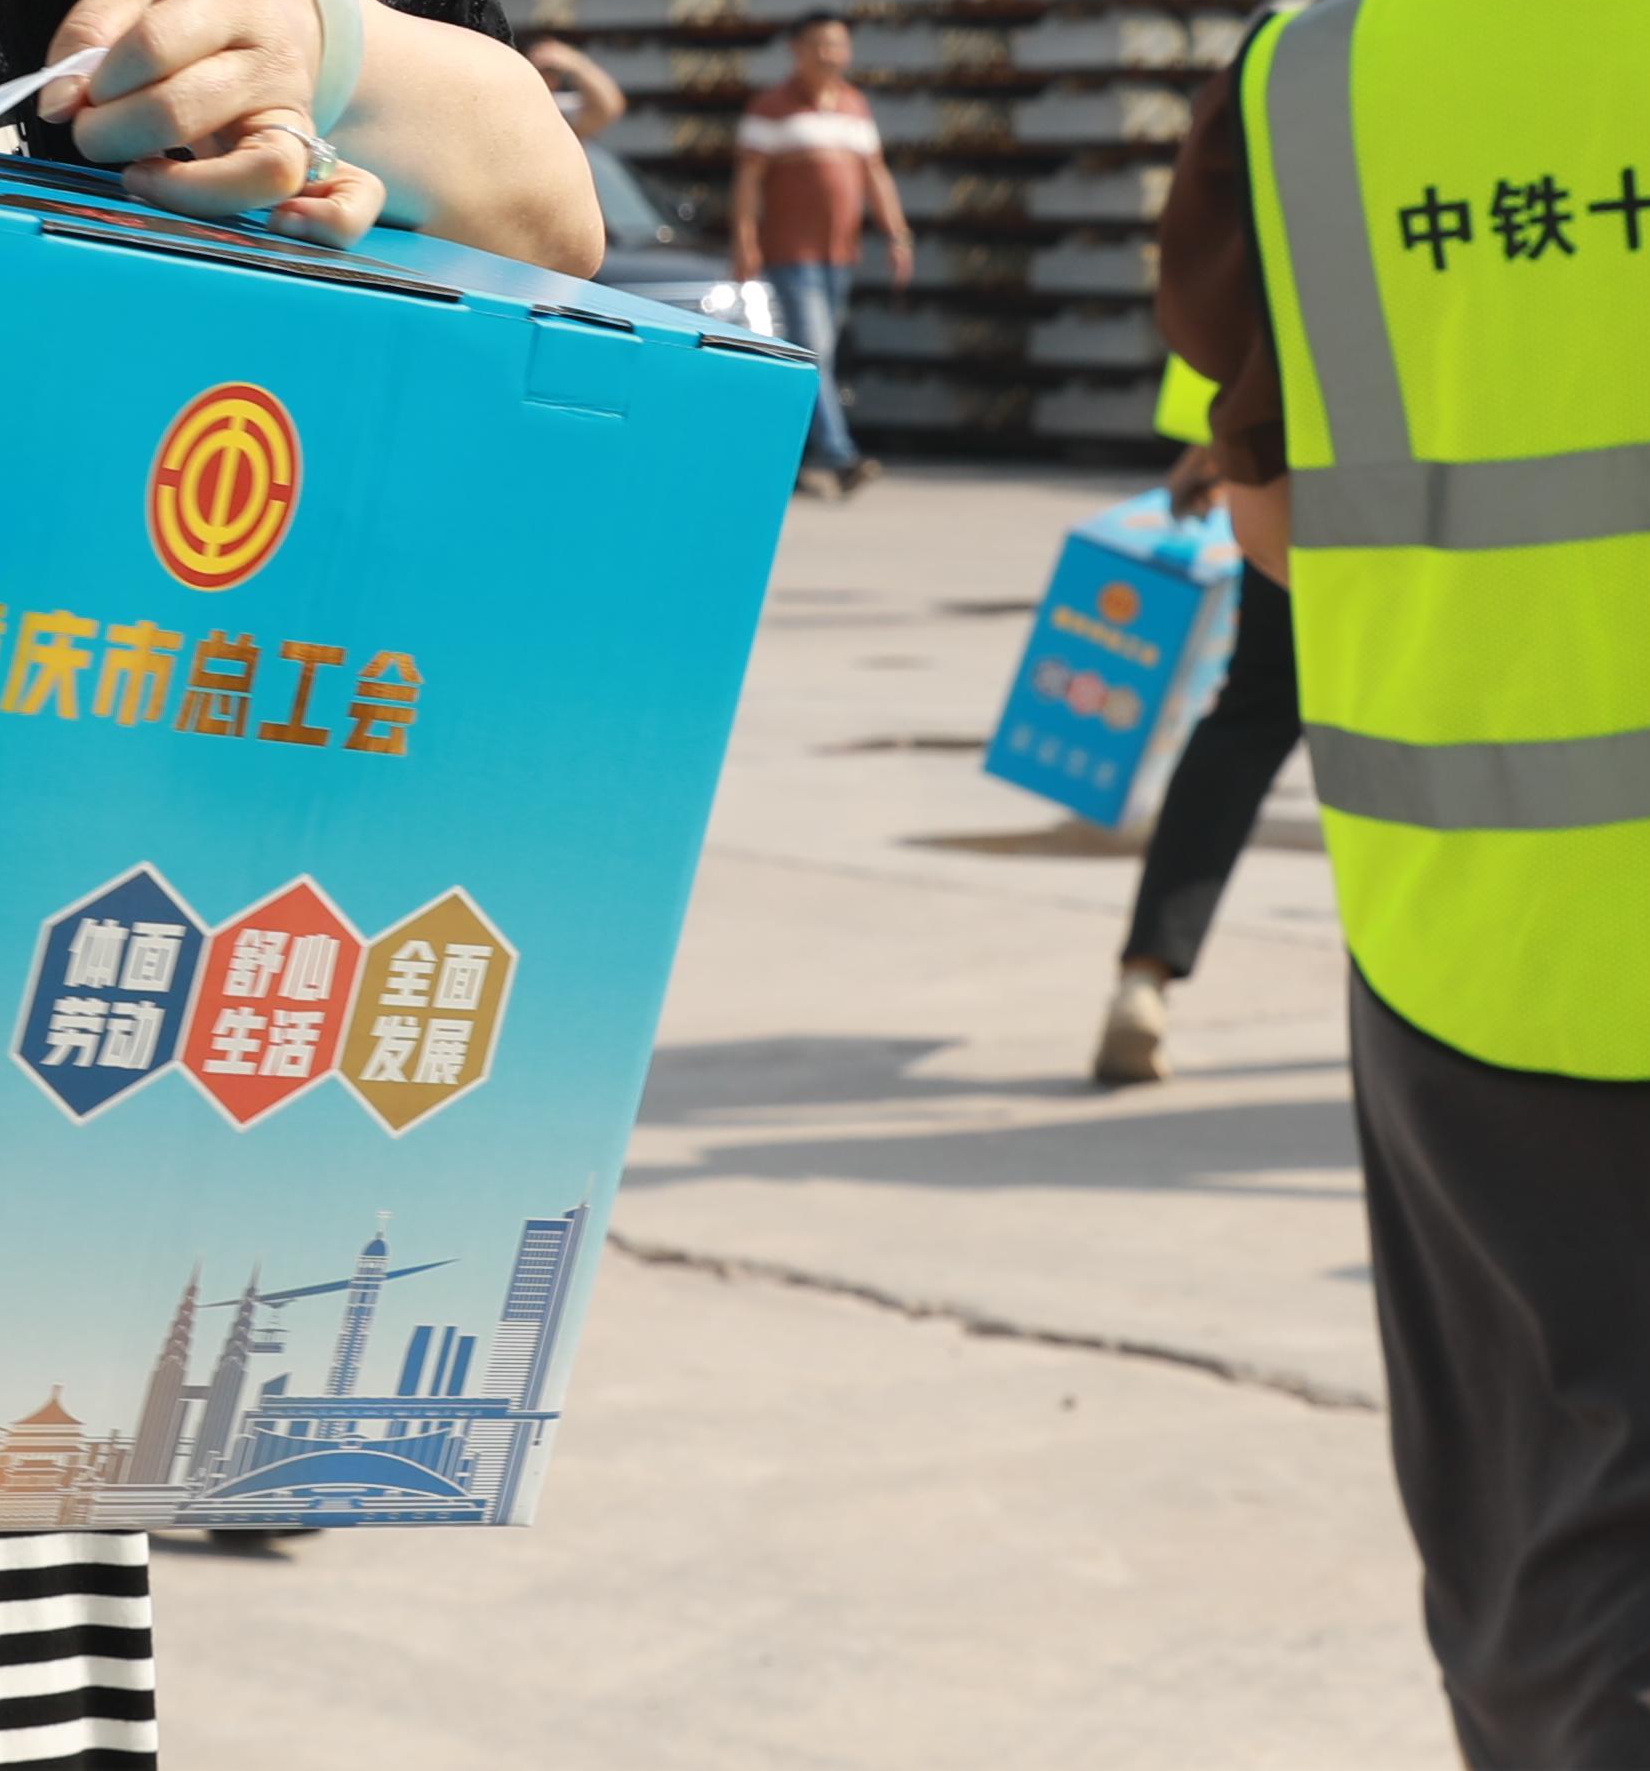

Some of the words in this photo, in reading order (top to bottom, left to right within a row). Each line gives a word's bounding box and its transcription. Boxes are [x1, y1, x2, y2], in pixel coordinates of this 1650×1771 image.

[63, 917, 186, 993] 体面
[222, 927, 341, 1002] 舒心
[378, 939, 494, 1011] 全面
[40, 996, 166, 1070] 劳动
[203, 1007, 326, 1078] 生活
[359, 1014, 475, 1085] 发展
